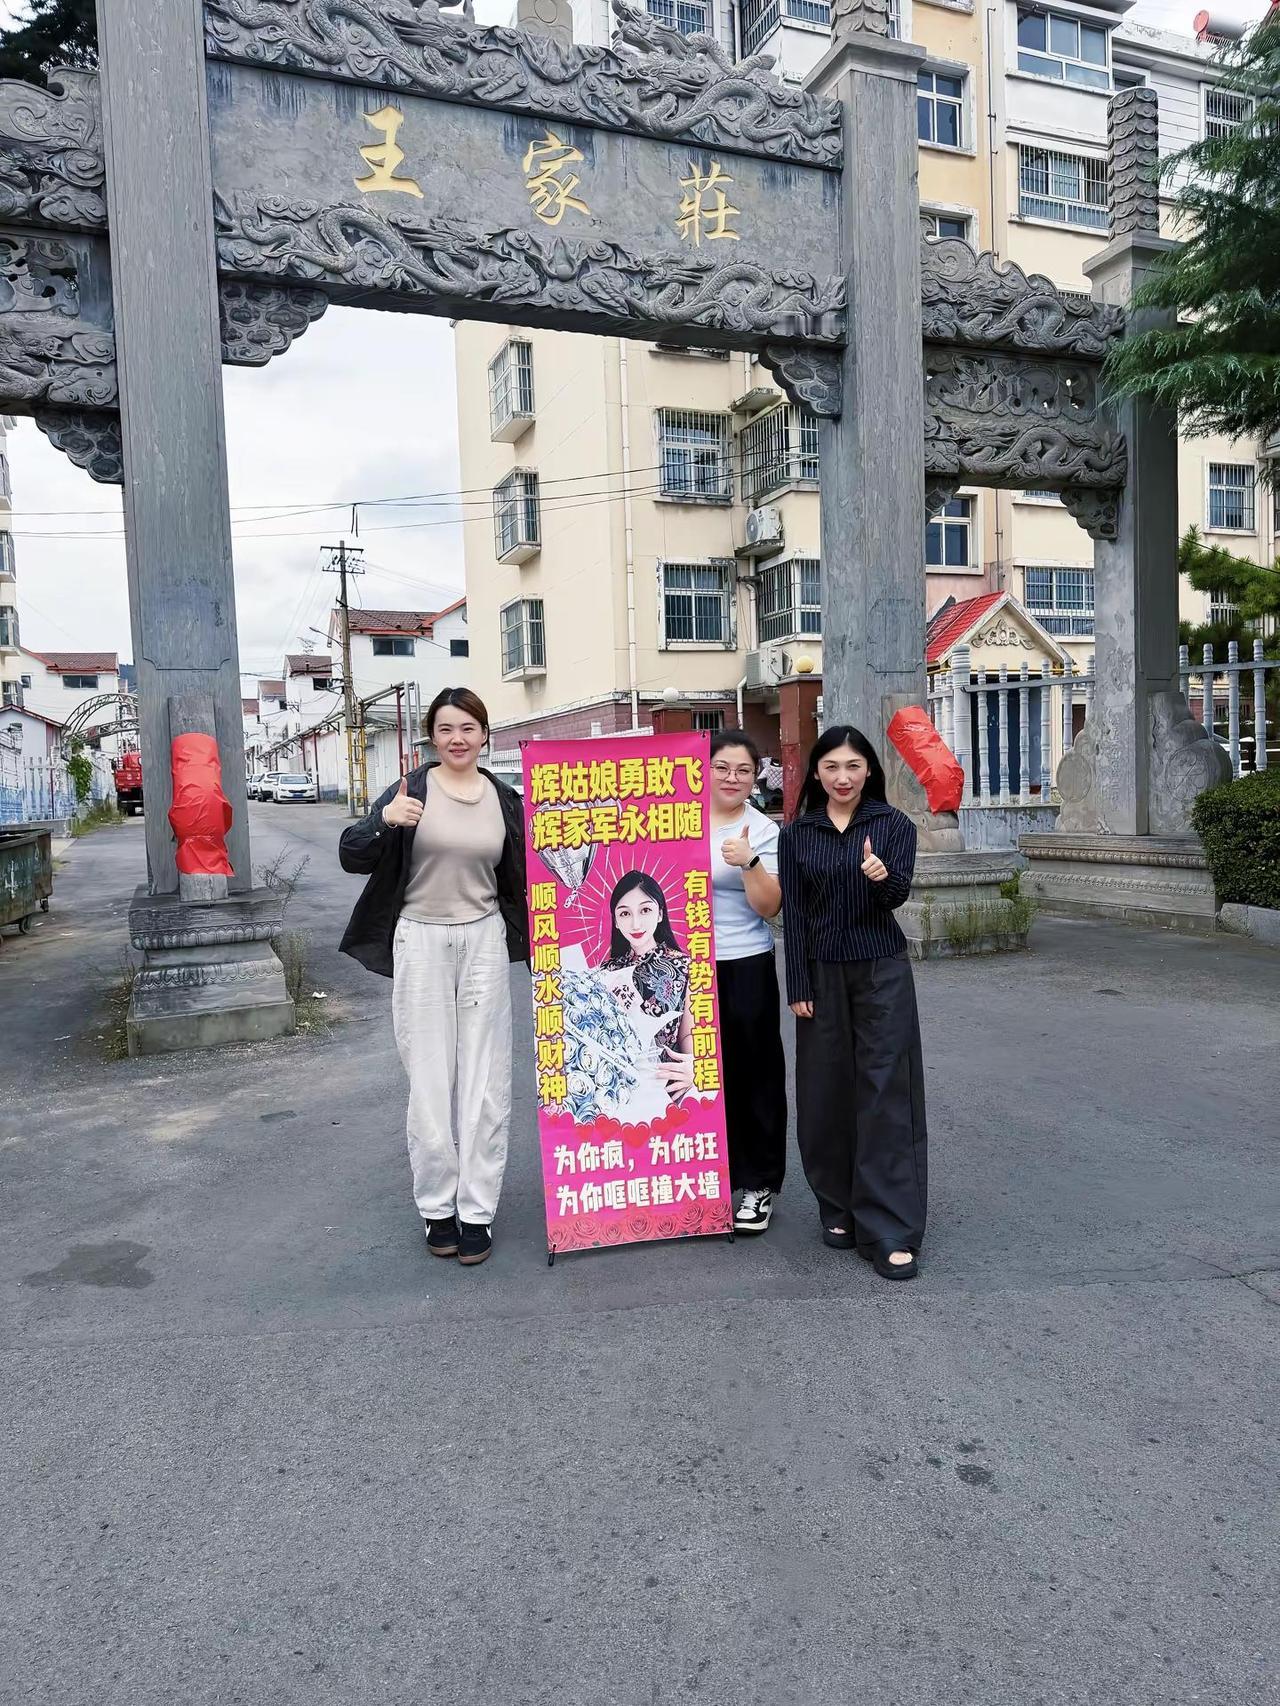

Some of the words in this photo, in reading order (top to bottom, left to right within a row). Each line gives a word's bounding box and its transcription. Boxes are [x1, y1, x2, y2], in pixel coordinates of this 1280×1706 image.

[353, 106, 741, 247] 王家莊
[530, 756, 704, 804] 辉姑娘勇敢飞
[532, 801, 703, 852] 辉家军永相随
[530, 881, 568, 1107] 顺风顺水顺财神
[683, 868, 721, 1093] 有钱有势有前程
[556, 1170, 721, 1217] 为你哐哐撞大墙
